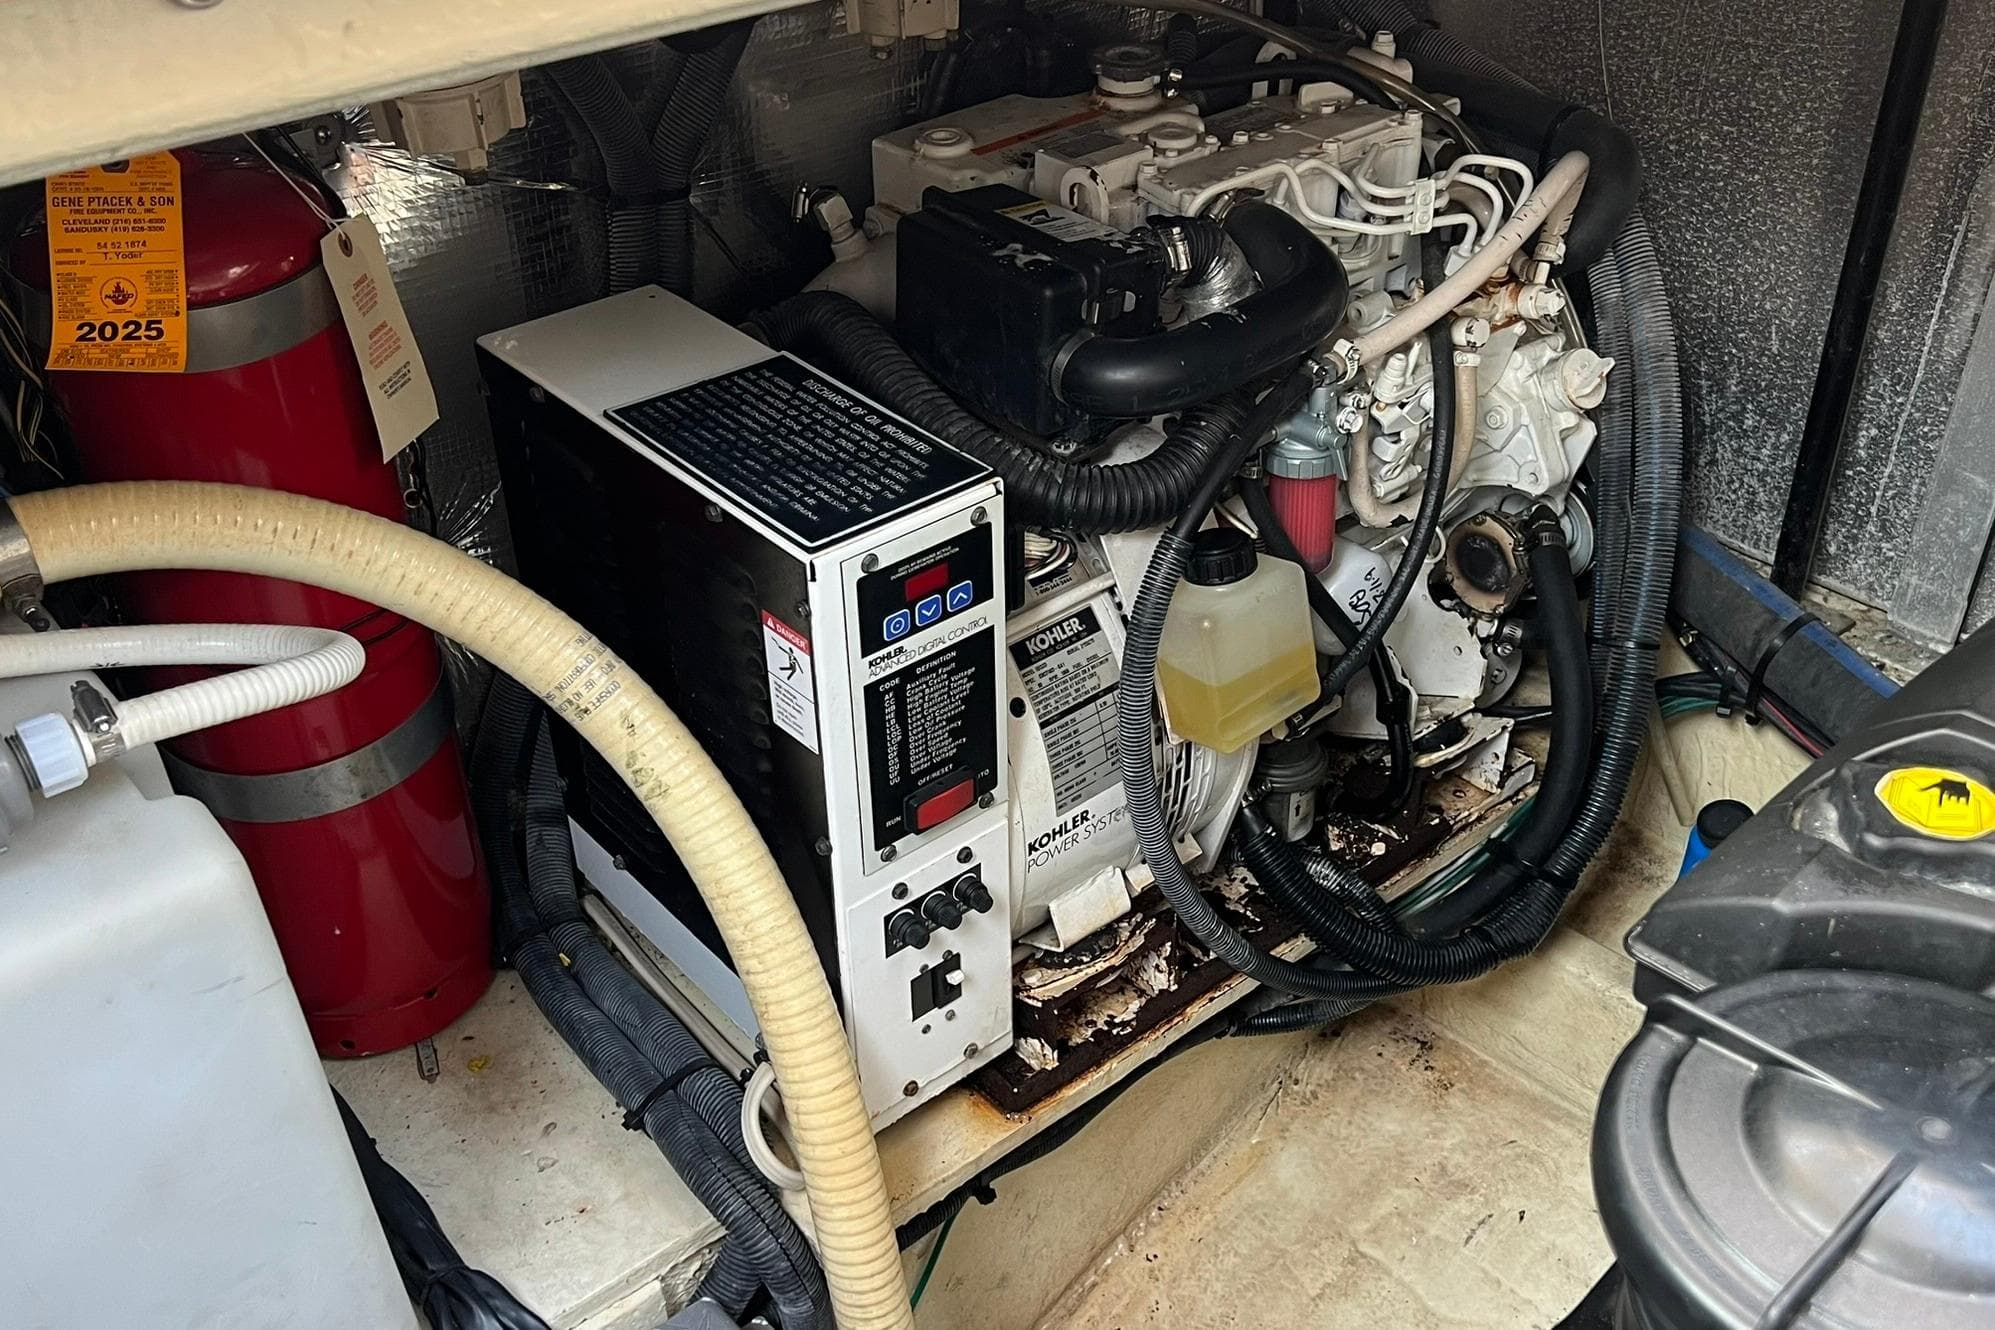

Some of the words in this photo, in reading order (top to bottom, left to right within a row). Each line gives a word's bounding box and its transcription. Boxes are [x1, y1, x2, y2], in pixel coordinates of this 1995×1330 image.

[52, 196, 84, 208] GENE
[88, 196, 133, 206] PTACEK
[137, 196, 146, 206] &
[150, 196, 175, 206] SON
[62, 218, 110, 226] CLEVELAND
[64, 226, 108, 234] SANDUSKY
[104, 252, 112, 260] T.
[114, 252, 144, 260] Yoder
[125, 240, 147, 248] 1874
[104, 292, 134, 300] NAFED
[75, 320, 165, 342] 2025
[798, 378, 856, 408] DISCHARGE
[845, 405, 871, 417] OF
[860, 413, 886, 426] OIL
[877, 423, 937, 454] PROHIBITED
[847, 421, 884, 441] CONTROL
[878, 439, 898, 449] ACT
[1364, 566, 1385, 604] 6.11.2
[776, 622, 806, 651] DANGER
[868, 647, 916, 680] ADVANCED
[917, 634, 945, 656] DIGITAL
[947, 613, 987, 643] CONTROL
[879, 676, 900, 693] CODE
[915, 649, 956, 675] DEFINITION
[906, 669, 936, 691] Auxiliary
[938, 660, 955, 675] Fault
[906, 690, 923, 705] High
[924, 677, 948, 696] Battery
[951, 664, 975, 683] Voltage
[884, 697, 895, 708] CC
[906, 682, 926, 697] Crank
[928, 671, 947, 687] Cycle
[907, 697, 923, 711] High
[924, 685, 948, 703] Engine
[923, 692, 947, 710] Battery
[949, 678, 974, 697] Voltage
[886, 722, 899, 735] LCL
[923, 697, 949, 716] Coolant
[951, 687, 969, 702] Level
[934, 698, 961, 717] Coolant
[887, 743, 898, 754] OC
[909, 729, 925, 743] Over
[926, 719, 946, 734] Crank
[909, 736, 925, 749] Over
[927, 717, 961, 742] Frequency
[909, 742, 926, 756] Over
[927, 730, 948, 748] Speed
[910, 748, 926, 762] Over
[927, 735, 952, 754] Voltage
[910, 753, 930, 769] Under
[932, 734, 967, 759] Frequency
[910, 759, 930, 775] Under
[932, 746, 956, 765] Voltage
[977, 767, 990, 780] TO
[885, 813, 901, 828] RUN
[1027, 831, 1079, 874] POWER
[1083, 803, 1130, 840] SYSTE
